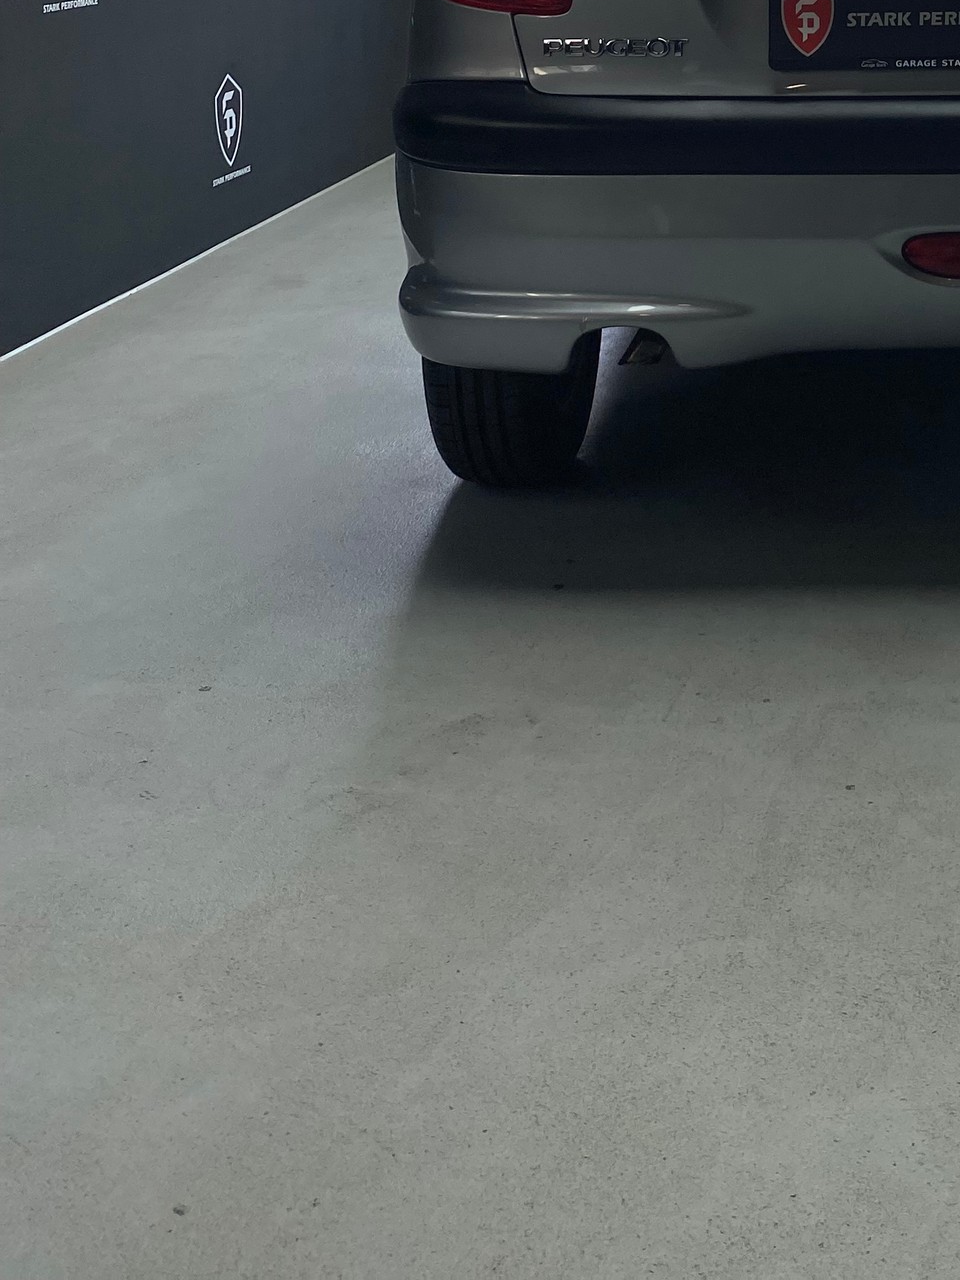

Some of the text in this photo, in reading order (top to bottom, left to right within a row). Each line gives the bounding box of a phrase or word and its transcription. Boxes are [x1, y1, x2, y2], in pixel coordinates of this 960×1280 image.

[43, 2, 61, 13] STARK
[847, 11, 912, 27] STARK
[543, 38, 689, 58] PEUGEOT
[895, 59, 937, 68] GARAGE
